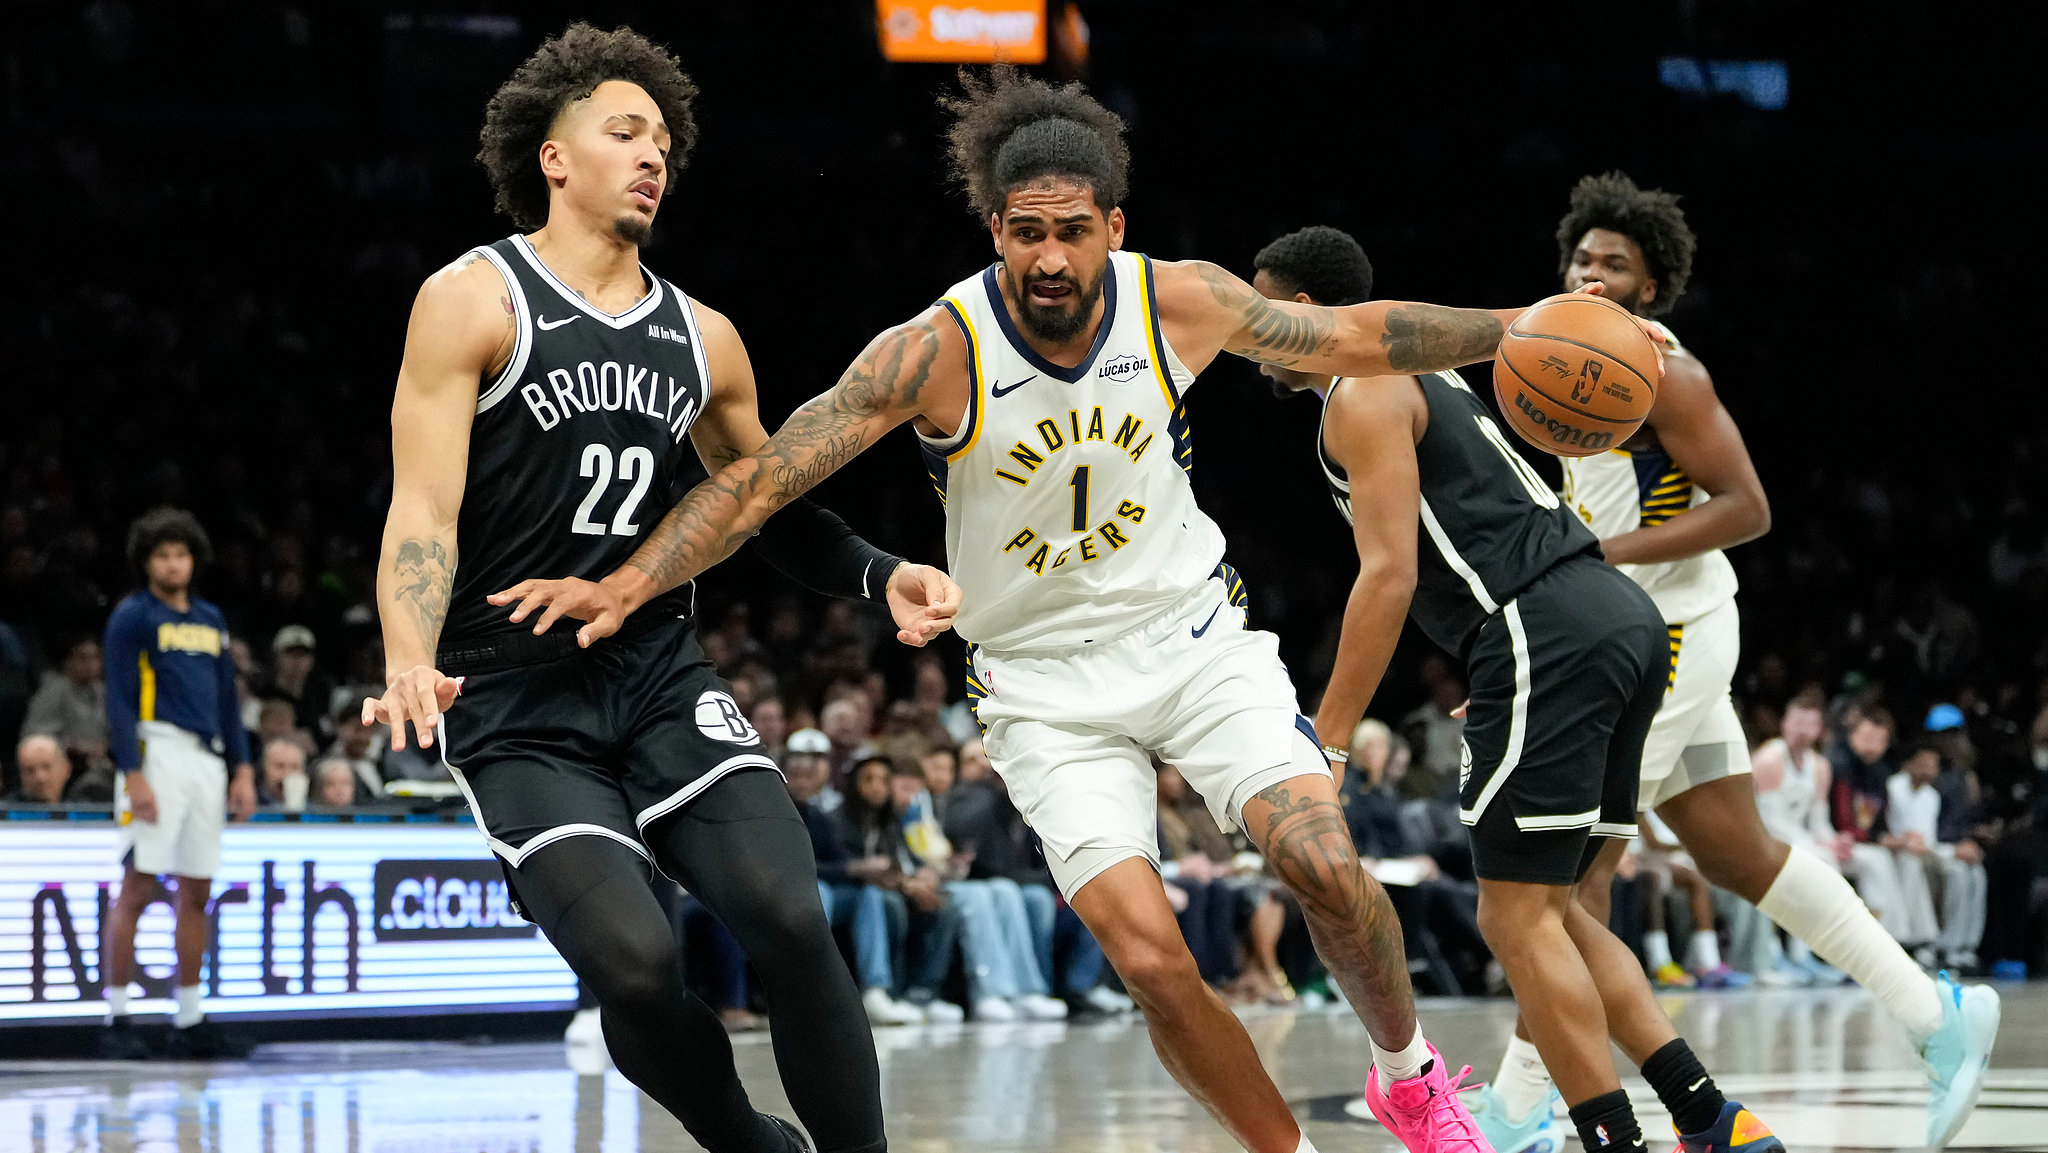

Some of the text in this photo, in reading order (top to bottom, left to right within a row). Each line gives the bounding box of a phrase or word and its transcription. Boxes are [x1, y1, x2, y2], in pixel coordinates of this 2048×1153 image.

[648, 324, 688, 345] All In Won
[1099, 359, 1149, 378] LUCAS OIL
[520, 361, 697, 444] BROOKLYN
[1514, 390, 1614, 449] Wilson
[995, 405, 1154, 487] INDIANA
[571, 443, 655, 537] 22
[1069, 464, 1091, 533] 1
[1002, 499, 1147, 577] PACERS
[714, 698, 749, 738] B
